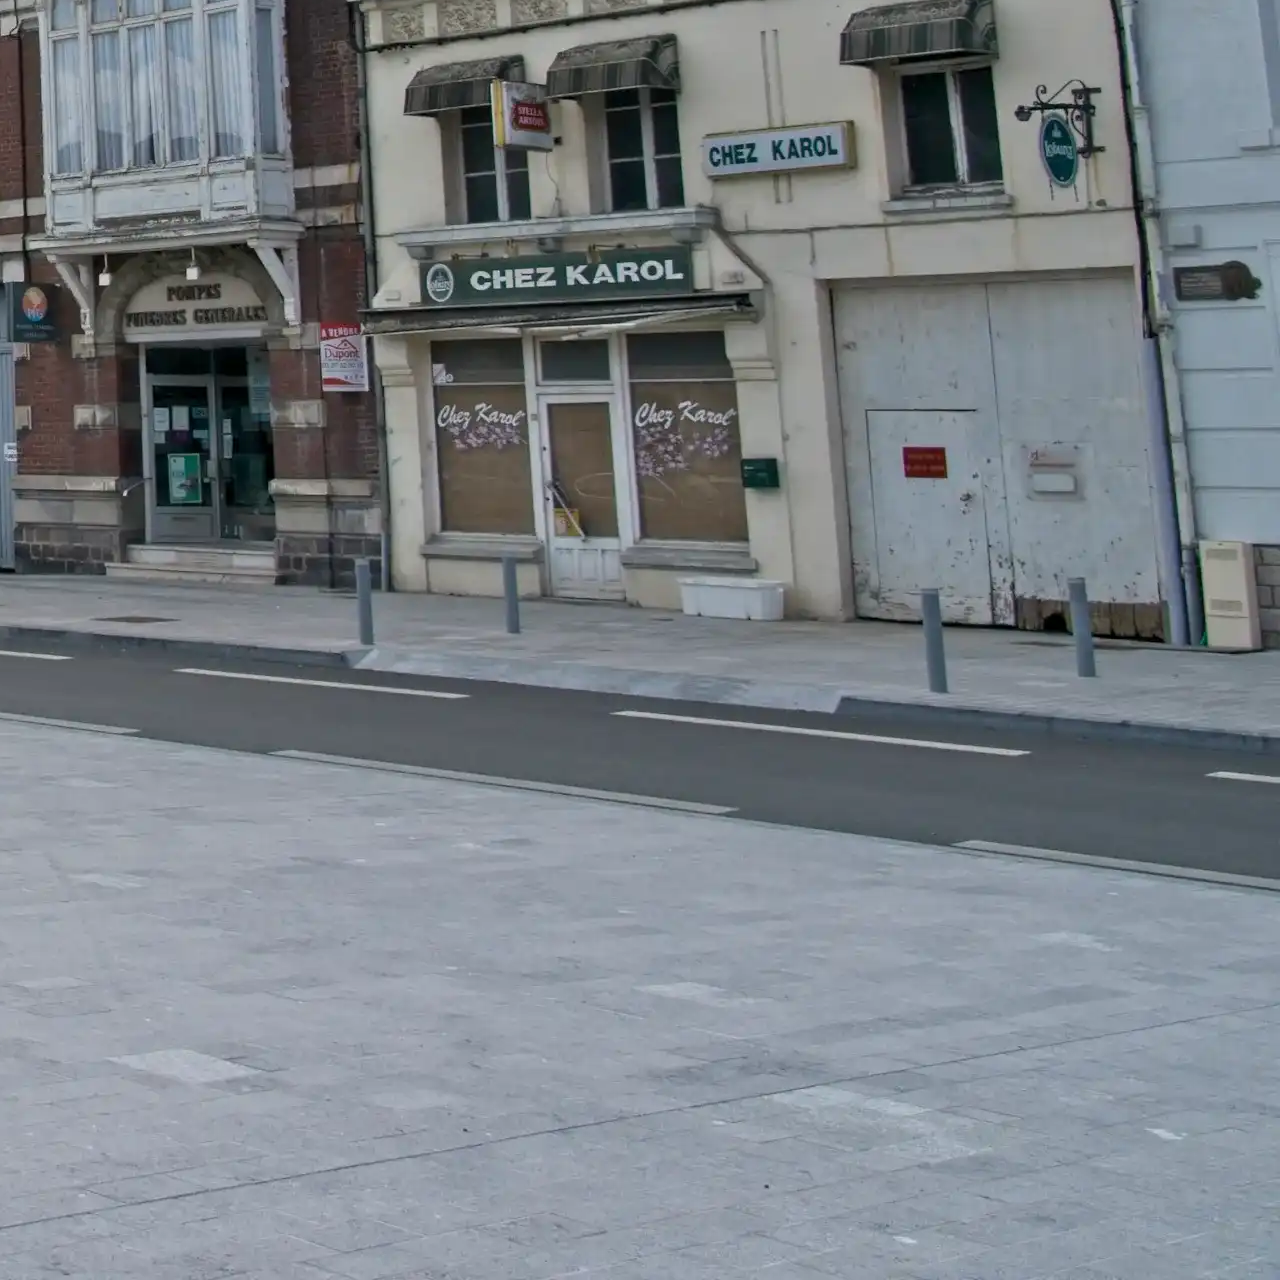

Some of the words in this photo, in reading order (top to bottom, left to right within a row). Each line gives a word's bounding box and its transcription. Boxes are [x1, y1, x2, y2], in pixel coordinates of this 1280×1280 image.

[709, 142, 758, 167] CHEZ
[772, 135, 838, 161] KAROL
[470, 267, 557, 291] CHEZ
[566, 259, 684, 286] KAROL
[167, 283, 222, 301] POMPES
[193, 305, 269, 324] GENERALES
[321, 328, 327, 338] A
[324, 348, 360, 359] Dupont
[437, 404, 471, 429] Chez
[475, 402, 526, 426] Karol
[635, 402, 675, 429] Chez
[678, 400, 737, 426] Karol
